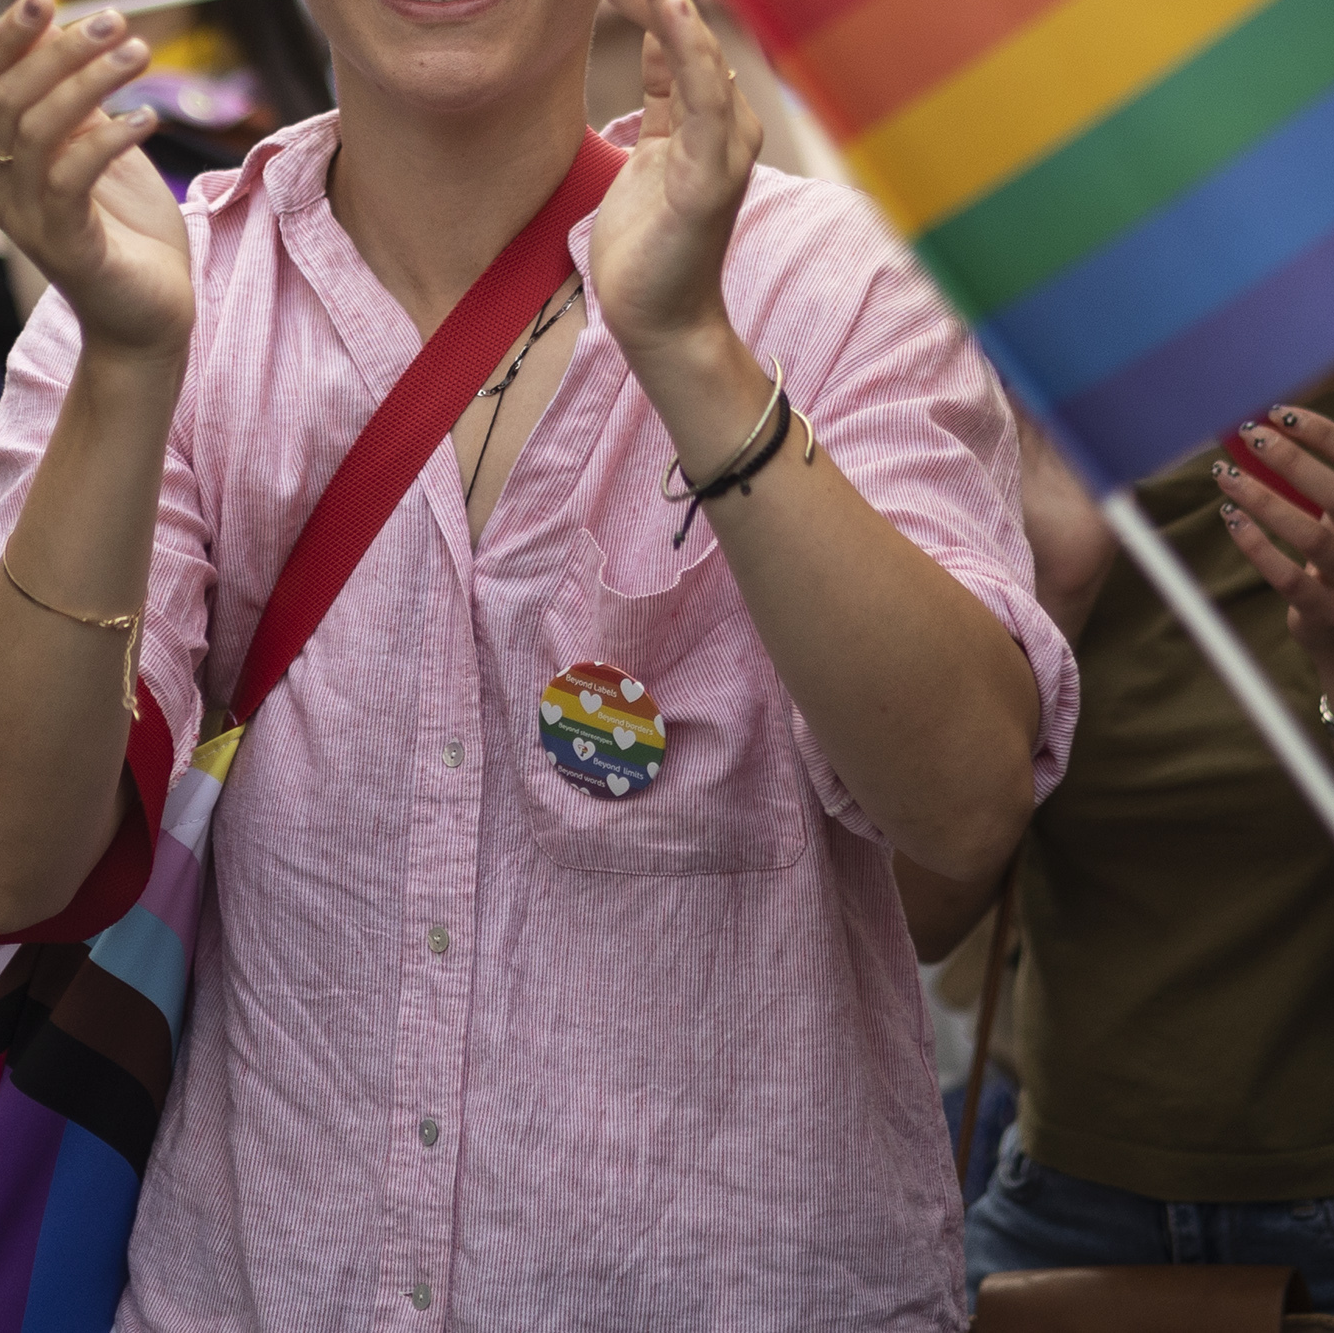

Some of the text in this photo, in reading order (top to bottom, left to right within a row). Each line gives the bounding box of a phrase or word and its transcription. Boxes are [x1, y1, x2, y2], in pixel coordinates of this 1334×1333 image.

[566, 673, 617, 698] Beyond Labels
[558, 722, 613, 746] Beyond stereotypes
[597, 711, 654, 736] Beyond borders
[558, 765, 606, 788] Beyond words
[593, 757, 644, 781] Beyond limits
